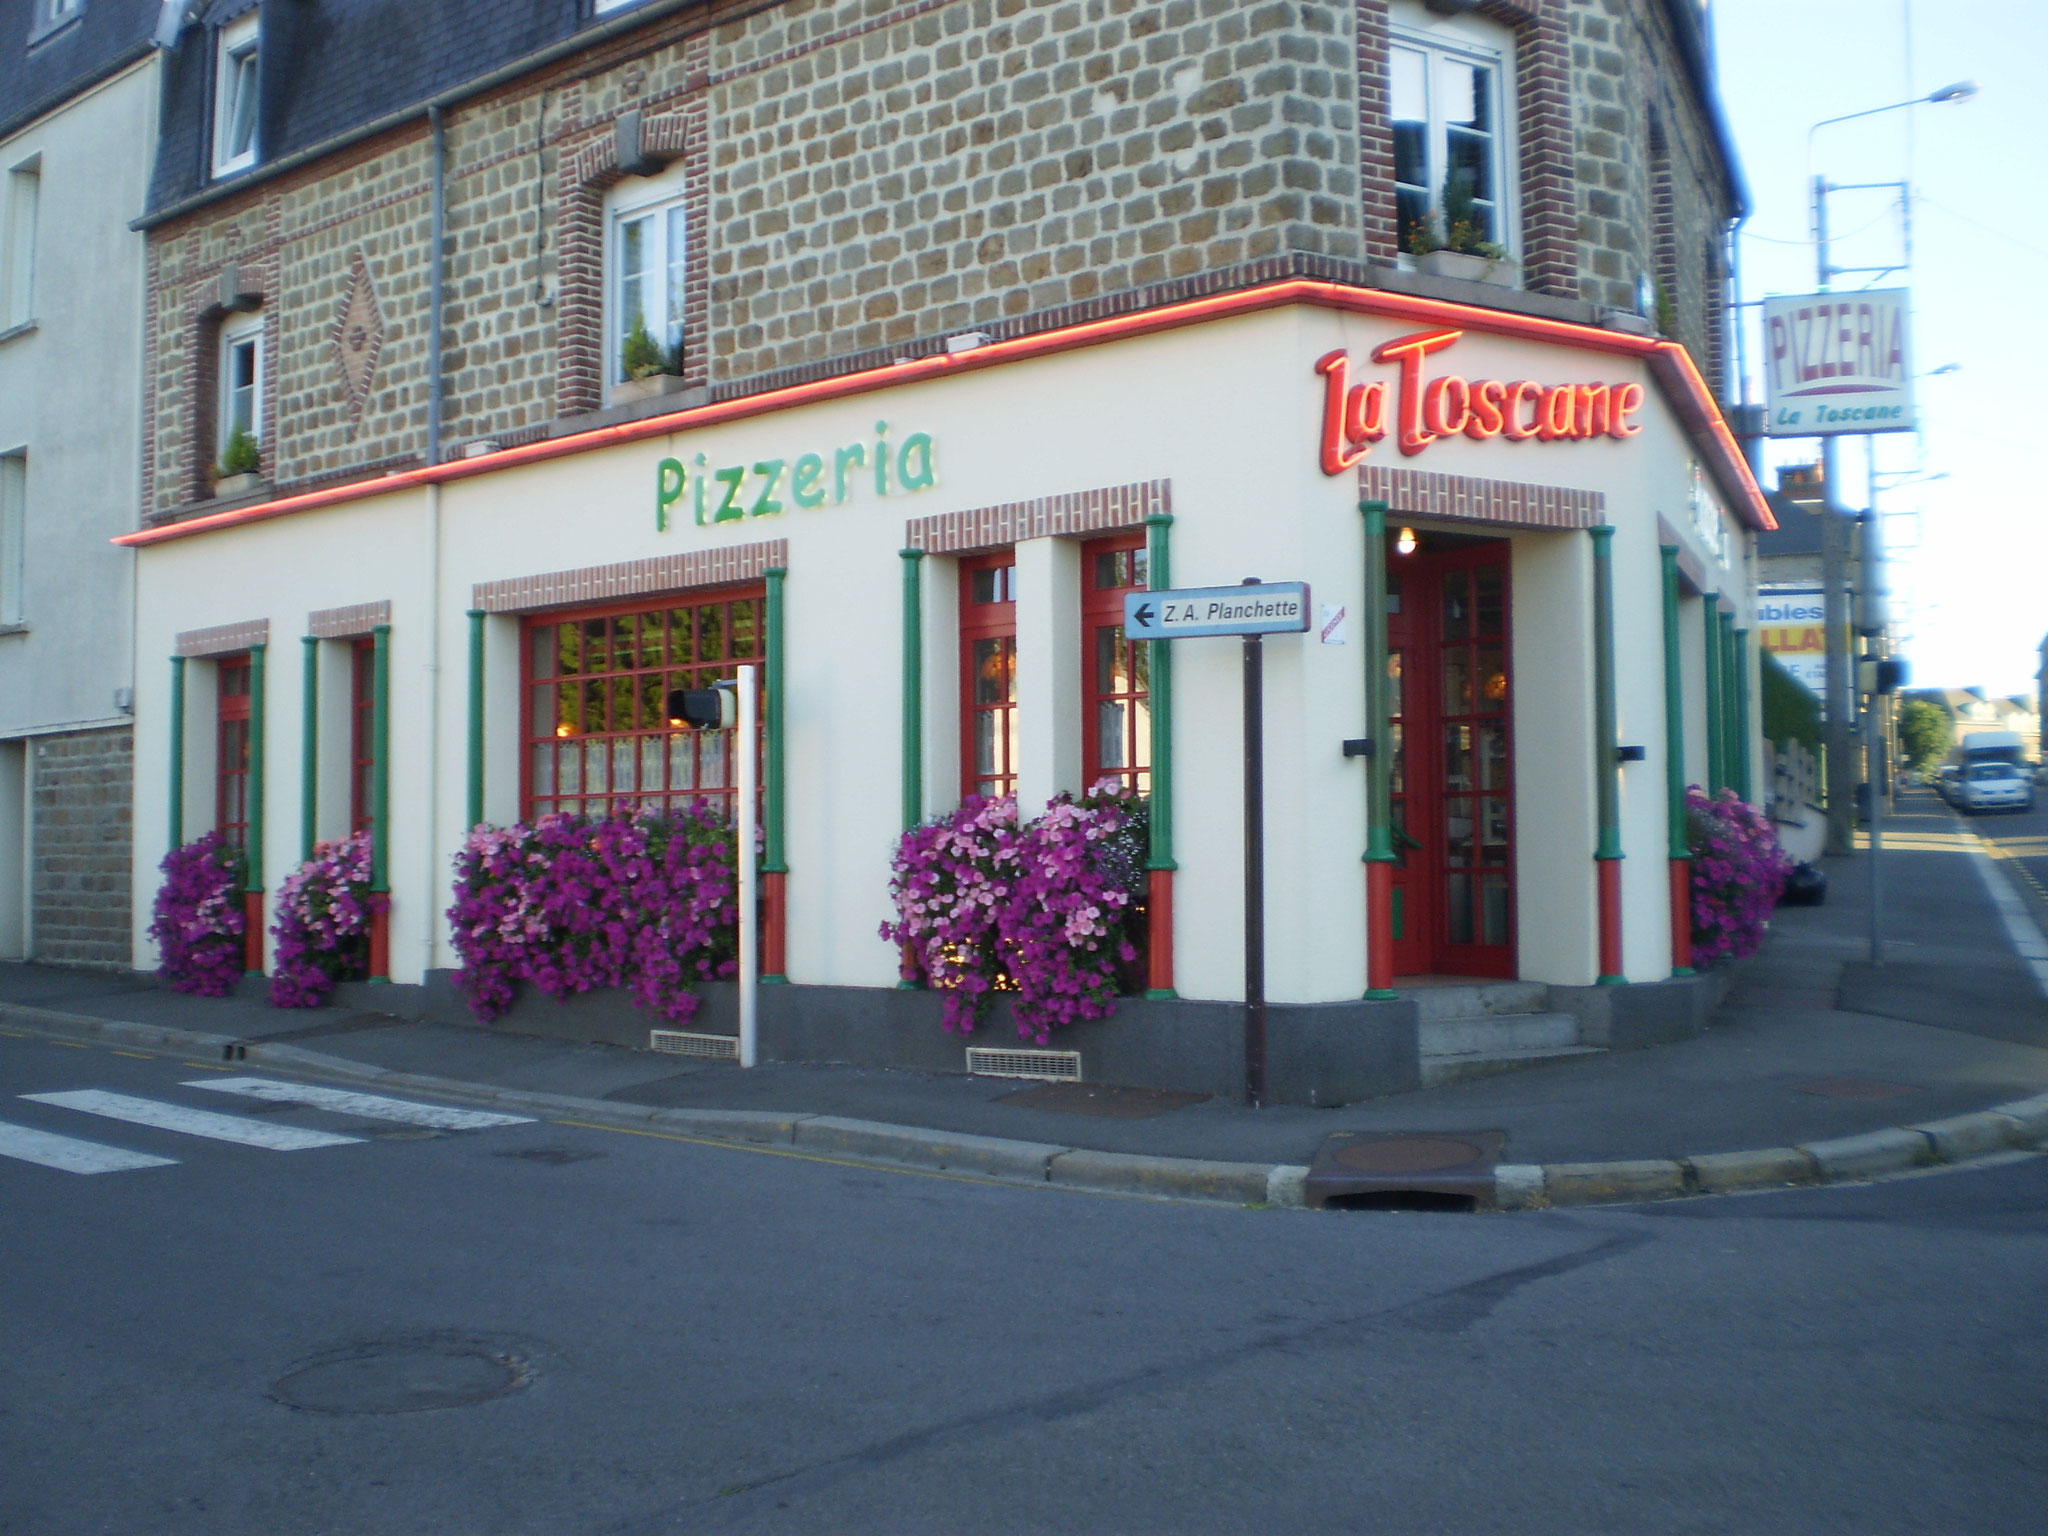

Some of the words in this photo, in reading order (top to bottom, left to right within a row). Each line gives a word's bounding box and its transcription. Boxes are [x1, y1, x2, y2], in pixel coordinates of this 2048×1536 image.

[1768, 303, 1907, 390] PIZZERIA
[1371, 329, 1645, 457] Toscane
[1815, 404, 1904, 423] Toscane
[656, 419, 937, 532] Pizzeria
[1207, 600, 1298, 620] Planchette
